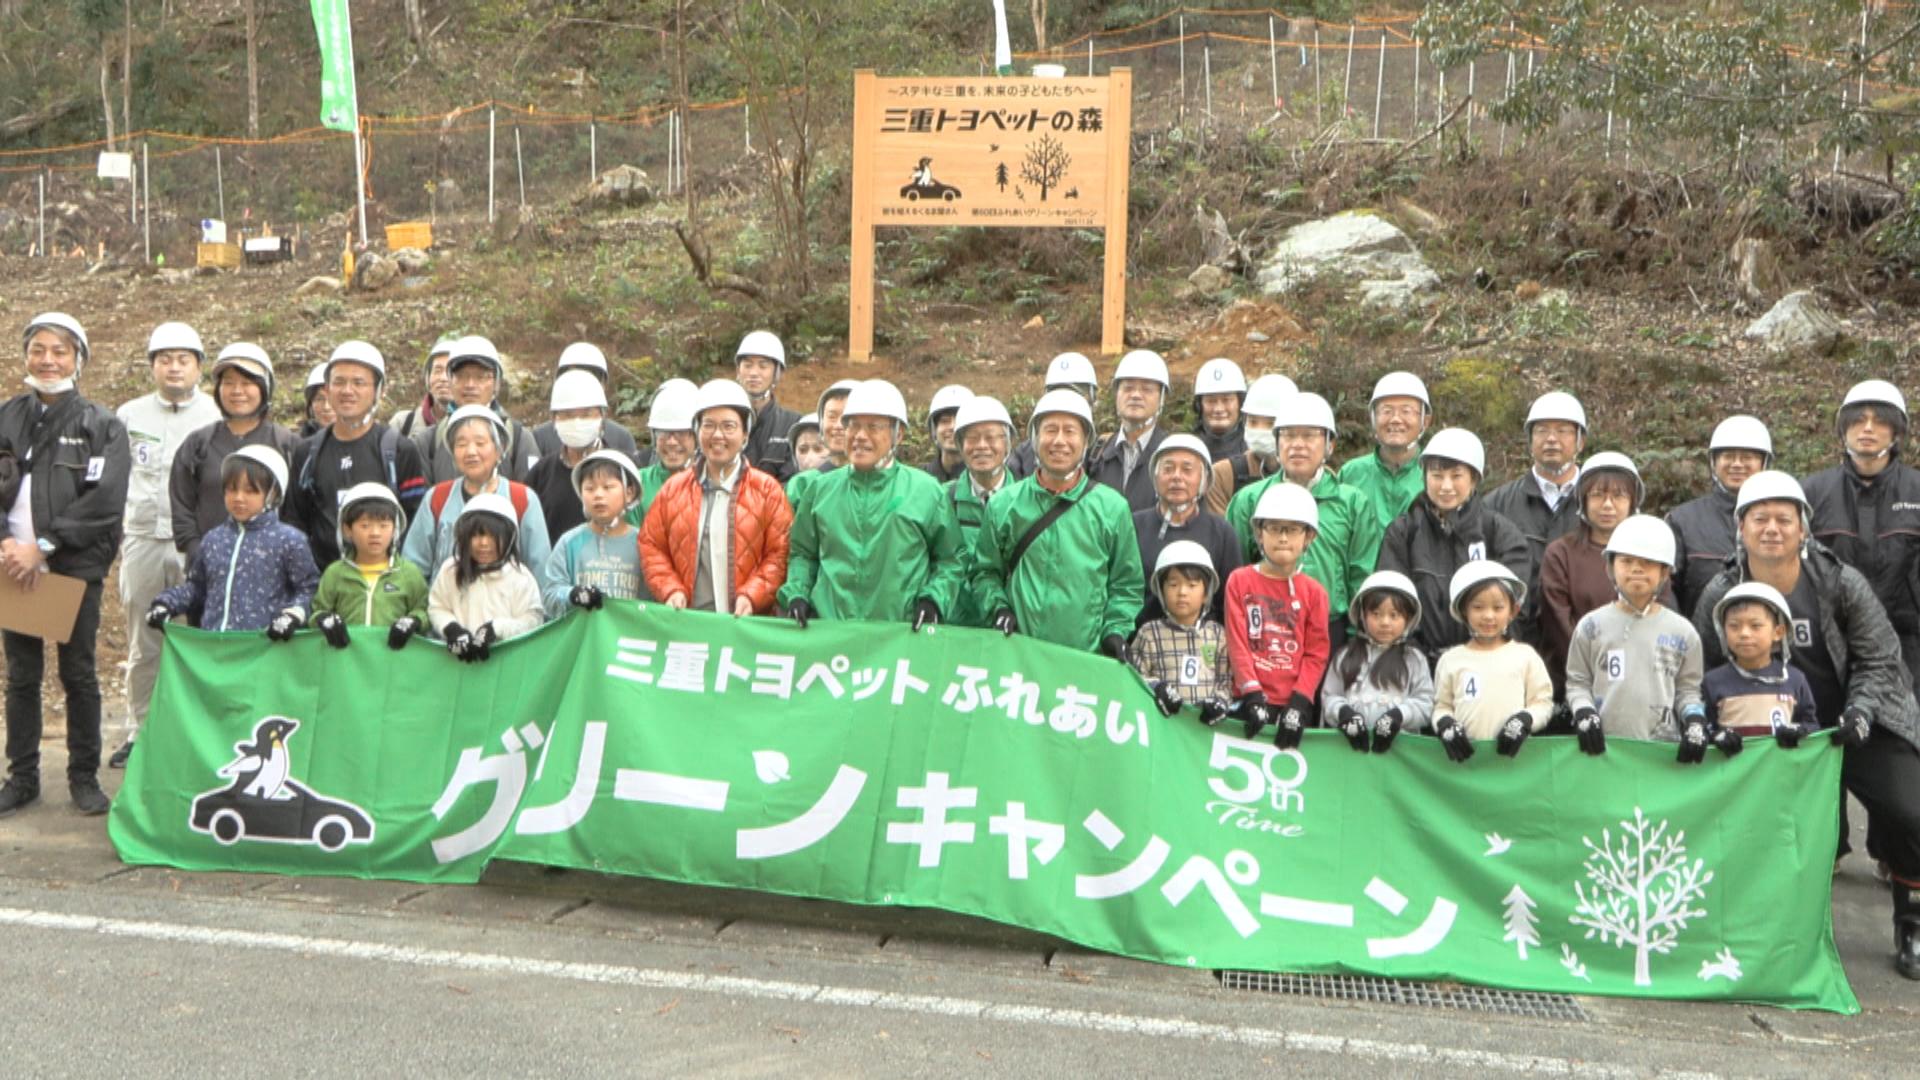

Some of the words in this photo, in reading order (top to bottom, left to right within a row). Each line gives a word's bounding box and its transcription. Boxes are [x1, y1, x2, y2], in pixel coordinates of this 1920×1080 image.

[881, 107, 1103, 133] 三重トヨペットの森
[88, 463, 99, 477] 4
[612, 572, 640, 589] TRU
[1251, 608, 1261, 628] 6
[1795, 623, 1809, 643] 6
[1185, 658, 1197, 679] 6
[1609, 656, 1621, 677] 6
[606, 637, 929, 704] 三重トヨペット
[941, 665, 1150, 747] ふれあい
[1465, 677, 1477, 697] 4
[1205, 800, 1306, 838] Time
[431, 720, 1459, 958] グリーンキャンペーン
